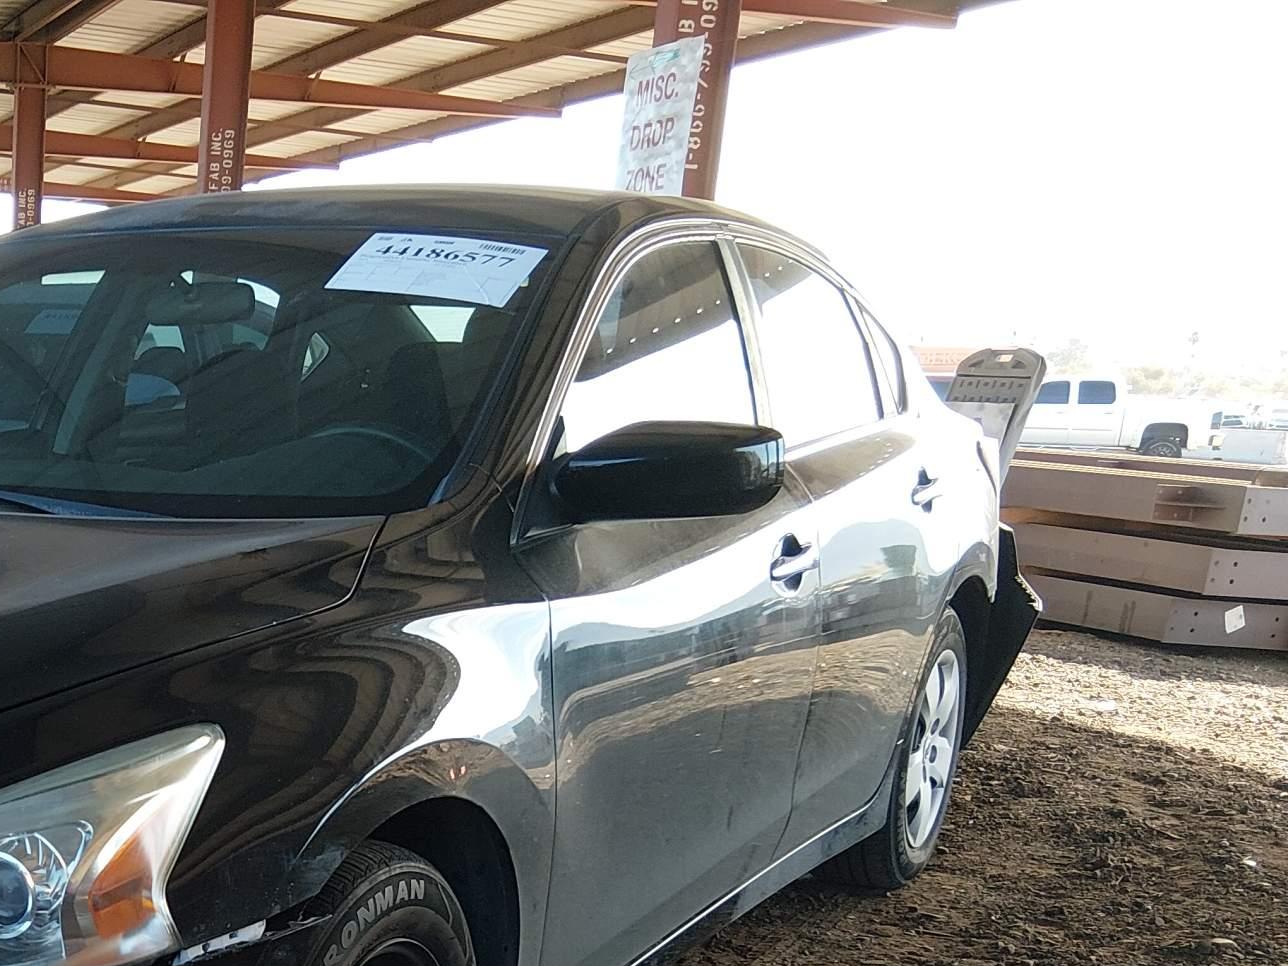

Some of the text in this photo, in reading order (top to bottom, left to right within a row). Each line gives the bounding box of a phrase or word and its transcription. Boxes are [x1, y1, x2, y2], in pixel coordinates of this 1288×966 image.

[636, 71, 680, 107] MISC.
[630, 117, 675, 152] DROP
[208, 127, 223, 193] FAB INC.
[625, 162, 667, 193] ZONE
[376, 244, 517, 268] 44186577
